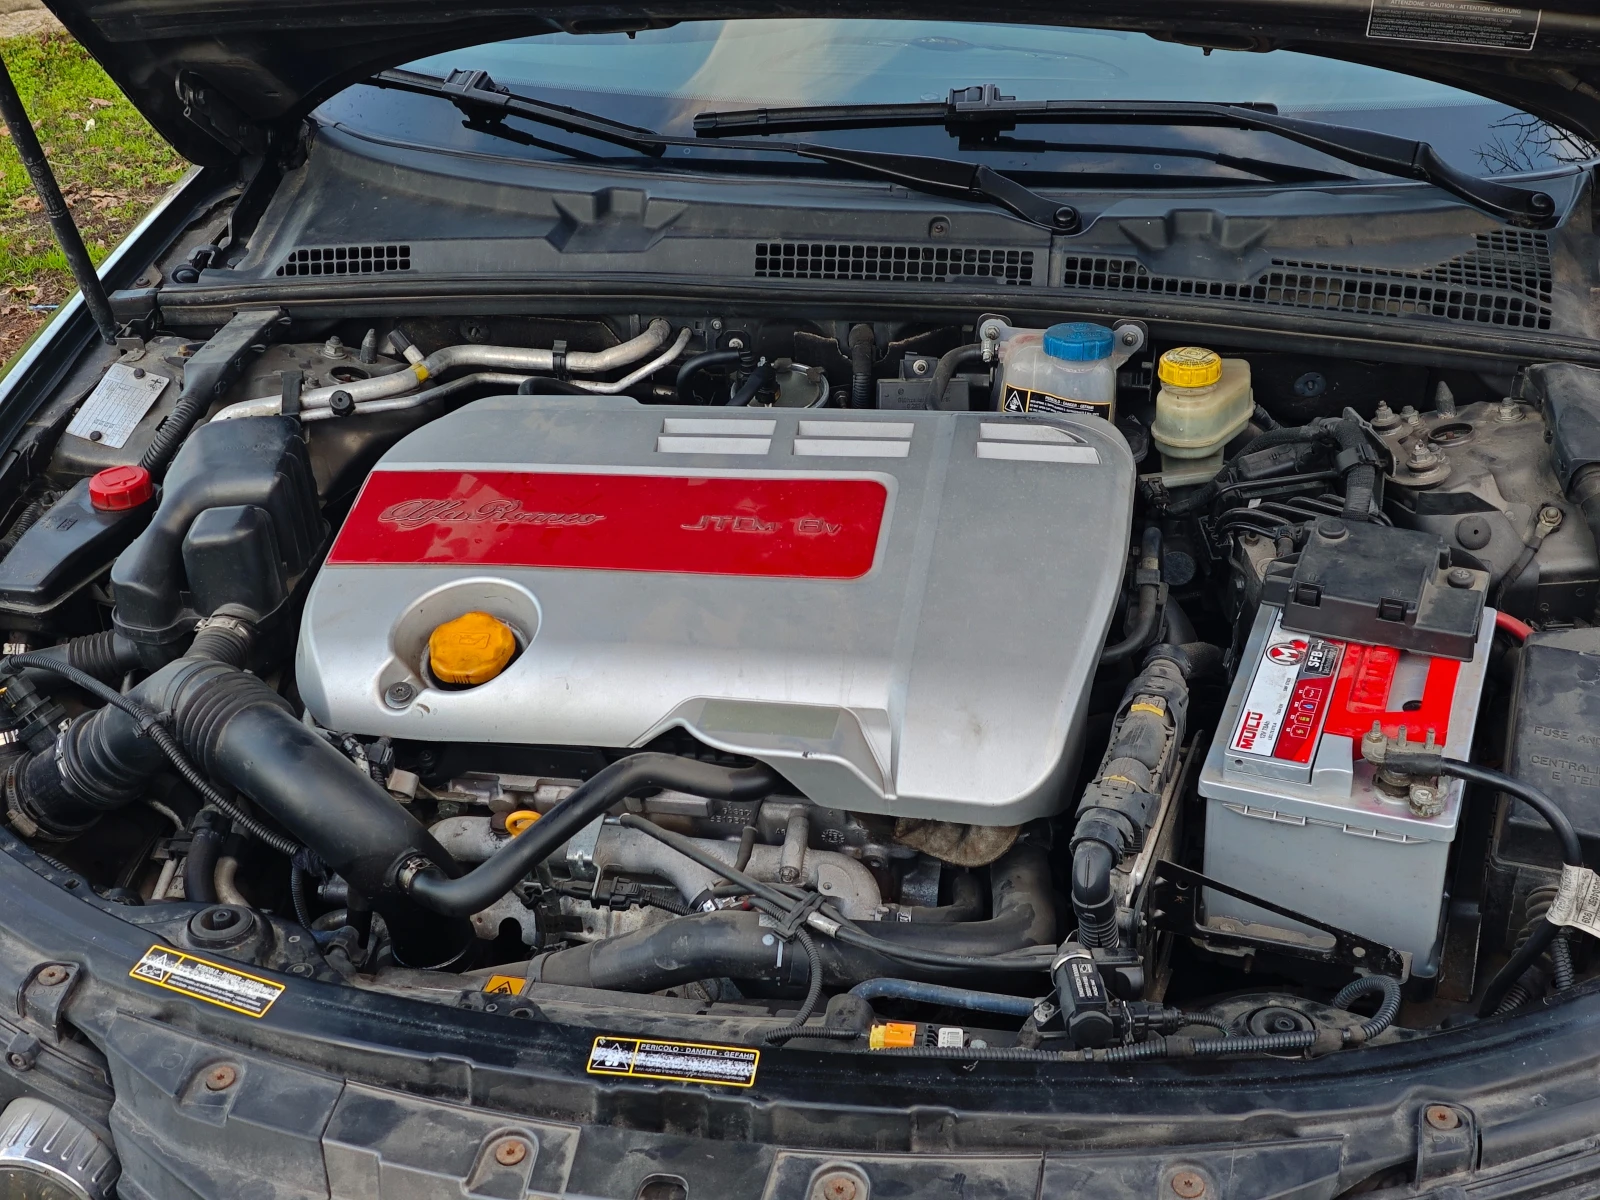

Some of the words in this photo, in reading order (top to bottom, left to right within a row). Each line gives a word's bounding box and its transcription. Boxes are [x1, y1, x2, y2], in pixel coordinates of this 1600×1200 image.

[474, 499, 607, 526] Romeo
[1308, 651, 1323, 667] SFB
[1534, 725, 1570, 740] FUSE
[1552, 771, 1561, 781] E
[1582, 912, 1593, 924] 939
[640, 1043, 679, 1053] PERICOLO
[685, 1047, 717, 1056] DANGER
[724, 1051, 755, 1060] GEFAHR
